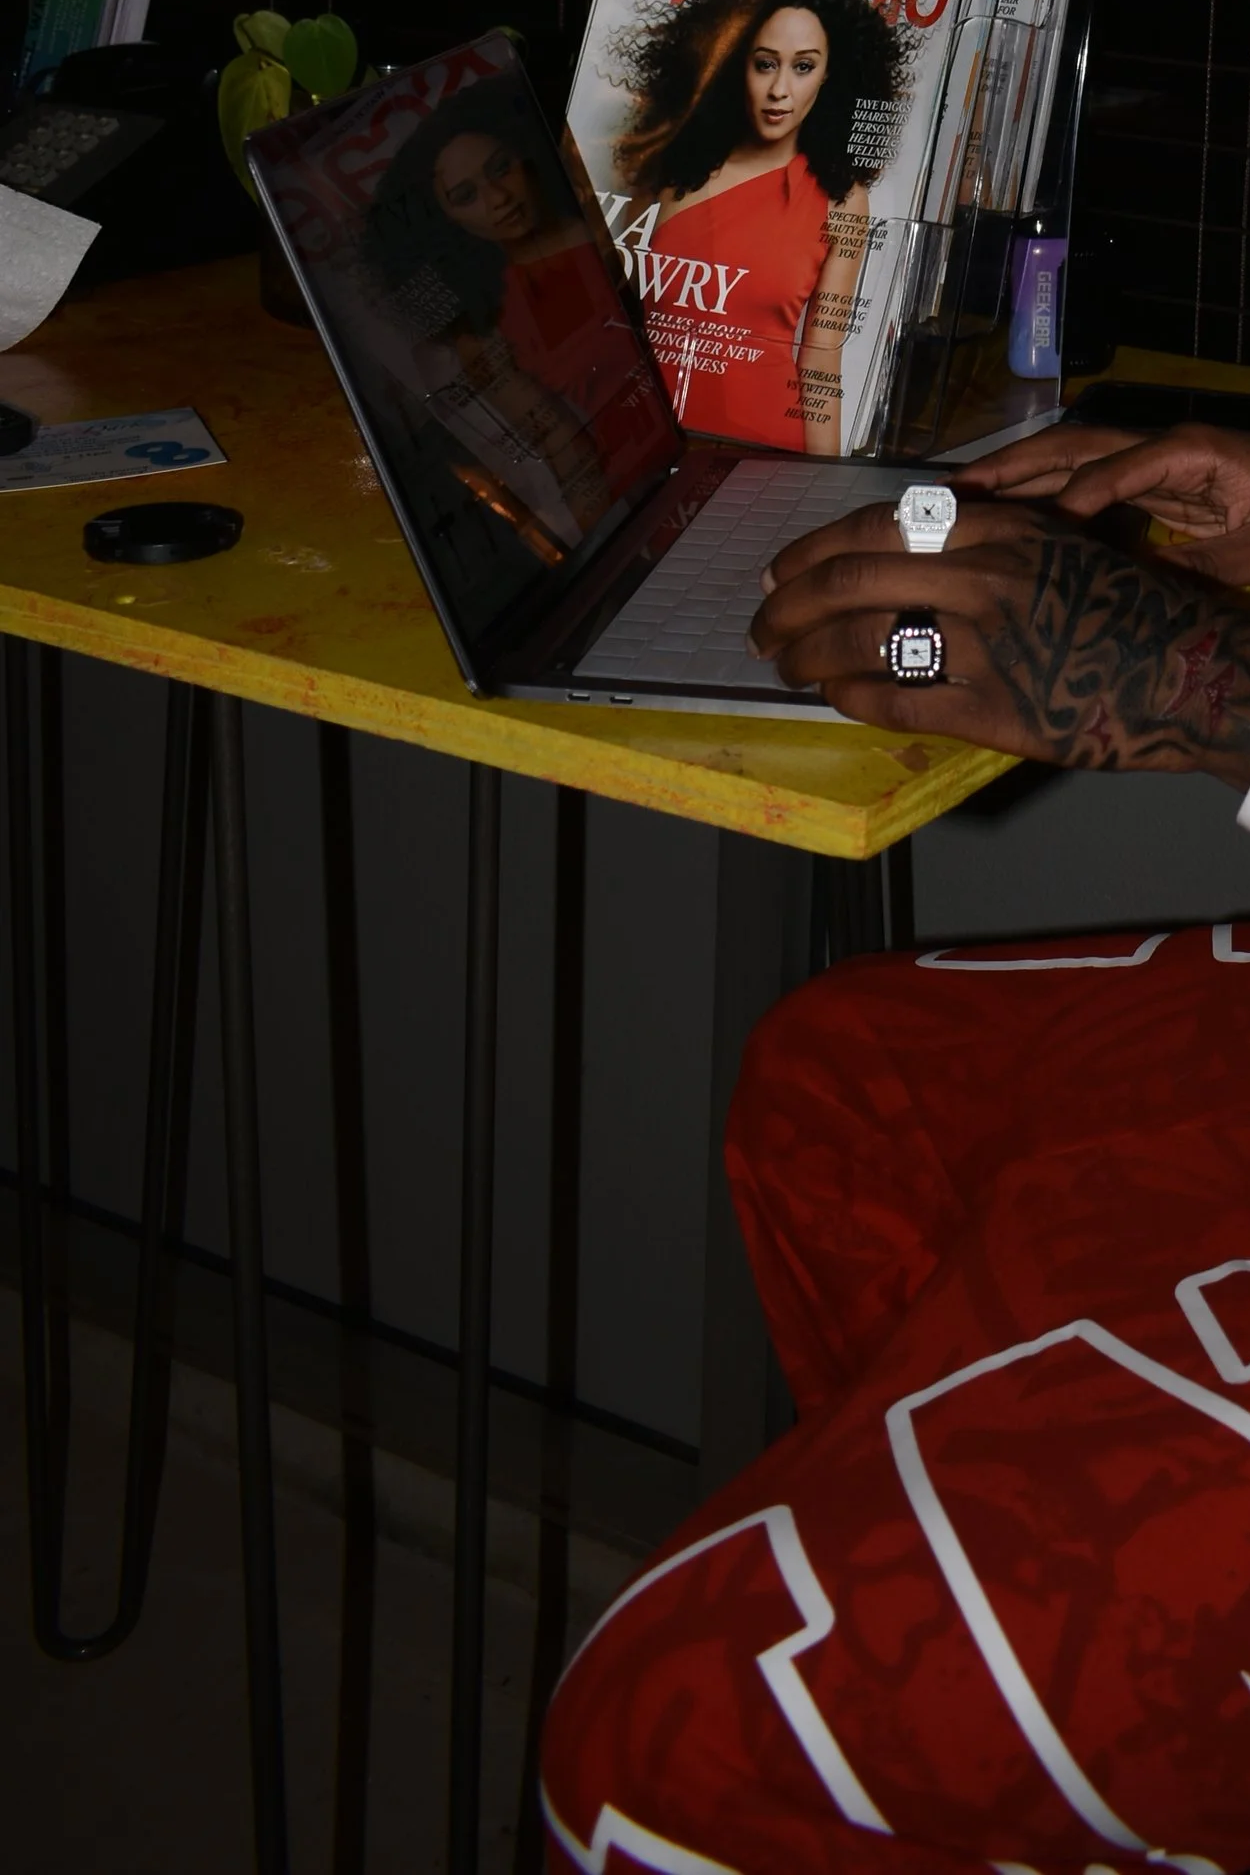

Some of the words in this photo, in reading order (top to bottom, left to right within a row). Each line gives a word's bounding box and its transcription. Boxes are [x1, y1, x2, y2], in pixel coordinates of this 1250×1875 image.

[855, 98, 879, 110] TAYE
[880, 100, 911, 113] DIGGS
[851, 110, 890, 123] SHARES
[891, 113, 909, 124] HIS
[851, 121, 903, 136] PERSONAL
[848, 132, 890, 146] HEALTH
[846, 144, 898, 159] WELLNESS
[852, 156, 887, 169] STORY
[820, 221, 856, 236] BEAUTY
[857, 228, 866, 236] &
[819, 234, 841, 245] TIPS
[841, 237, 866, 248] ONLY
[839, 248, 860, 260] YOU
[817, 292, 839, 303] OUR
[1036, 271, 1051, 313] GEEK
[815, 305, 829, 315] TO
[697, 320, 752, 342] ABOUT
[811, 318, 863, 334] BARBADOS
[1035, 316, 1050, 347] BAR
[724, 344, 765, 363] NEW
[799, 369, 842, 384] THREADS
[796, 396, 828, 410] FIGHT
[784, 407, 816, 422] HEATS
[817, 414, 831, 424] UP
